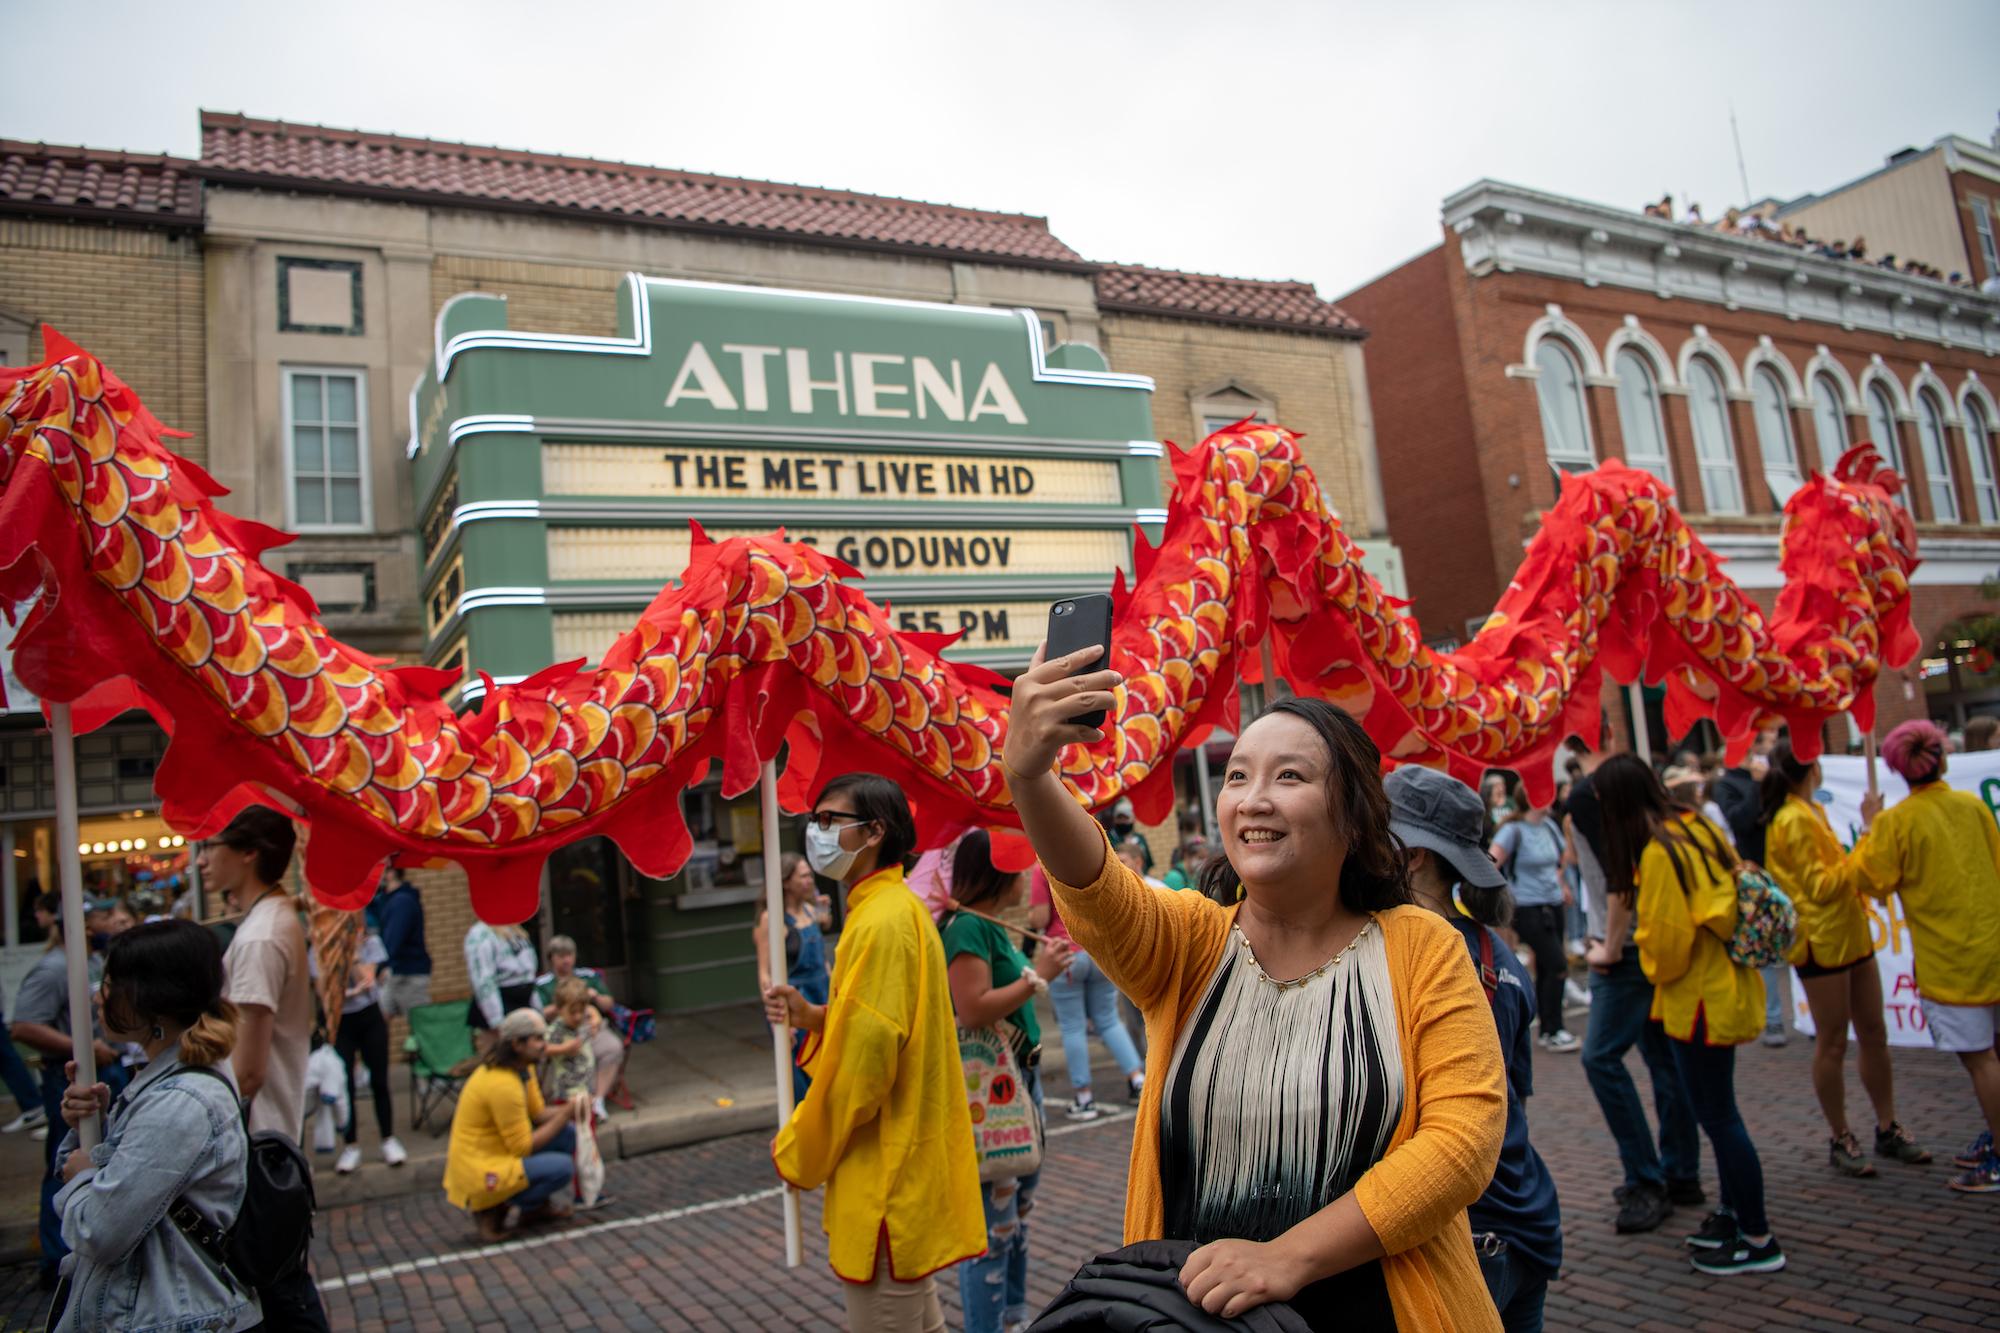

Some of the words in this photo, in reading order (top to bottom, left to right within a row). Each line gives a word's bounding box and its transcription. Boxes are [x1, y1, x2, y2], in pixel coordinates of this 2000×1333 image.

[664, 341, 1029, 425] ATHENA
[665, 454, 747, 489] THE
[762, 457, 843, 492] MET
[856, 459, 936, 494] LIVE
[945, 463, 981, 494] IN
[990, 464, 1035, 496] HD
[835, 535, 1011, 569] GODUNOV
[958, 609, 1010, 642] PM
[983, 1126, 1032, 1147] POWER
